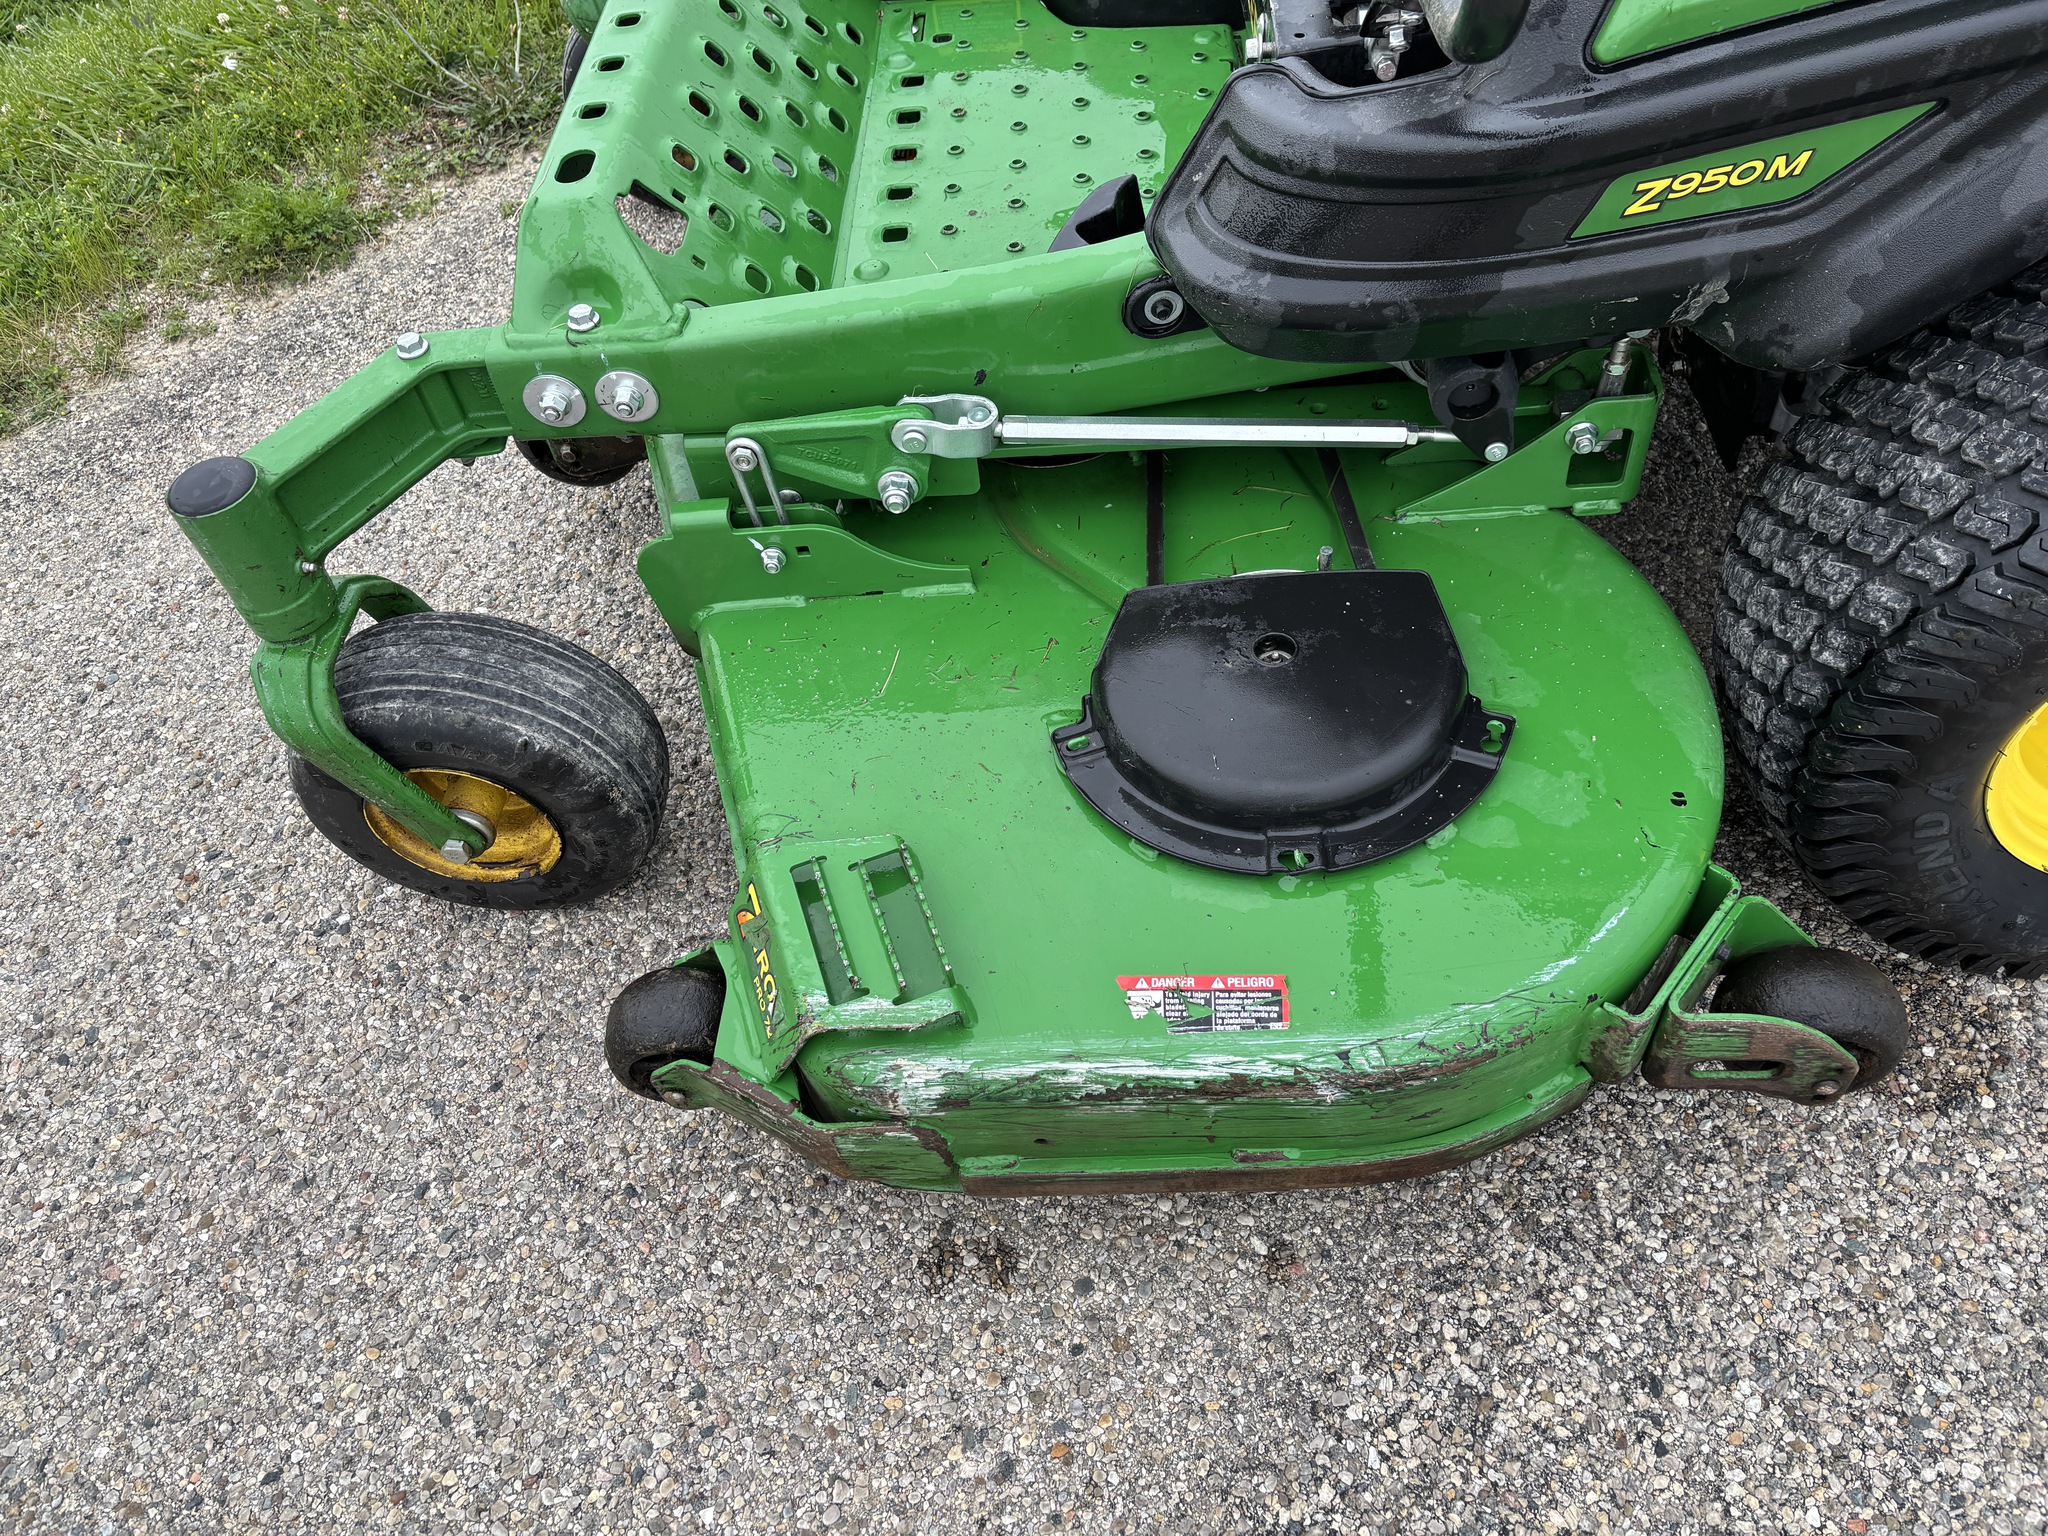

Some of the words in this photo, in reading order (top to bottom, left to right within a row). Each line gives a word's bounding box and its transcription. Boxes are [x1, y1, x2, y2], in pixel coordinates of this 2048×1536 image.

[1621, 147, 1816, 217] Z950M
[1151, 976, 1195, 988] DANGER
[1227, 977, 1275, 988] PELIGRO
[753, 975, 767, 1012] PRO
[1192, 991, 1211, 999] injury
